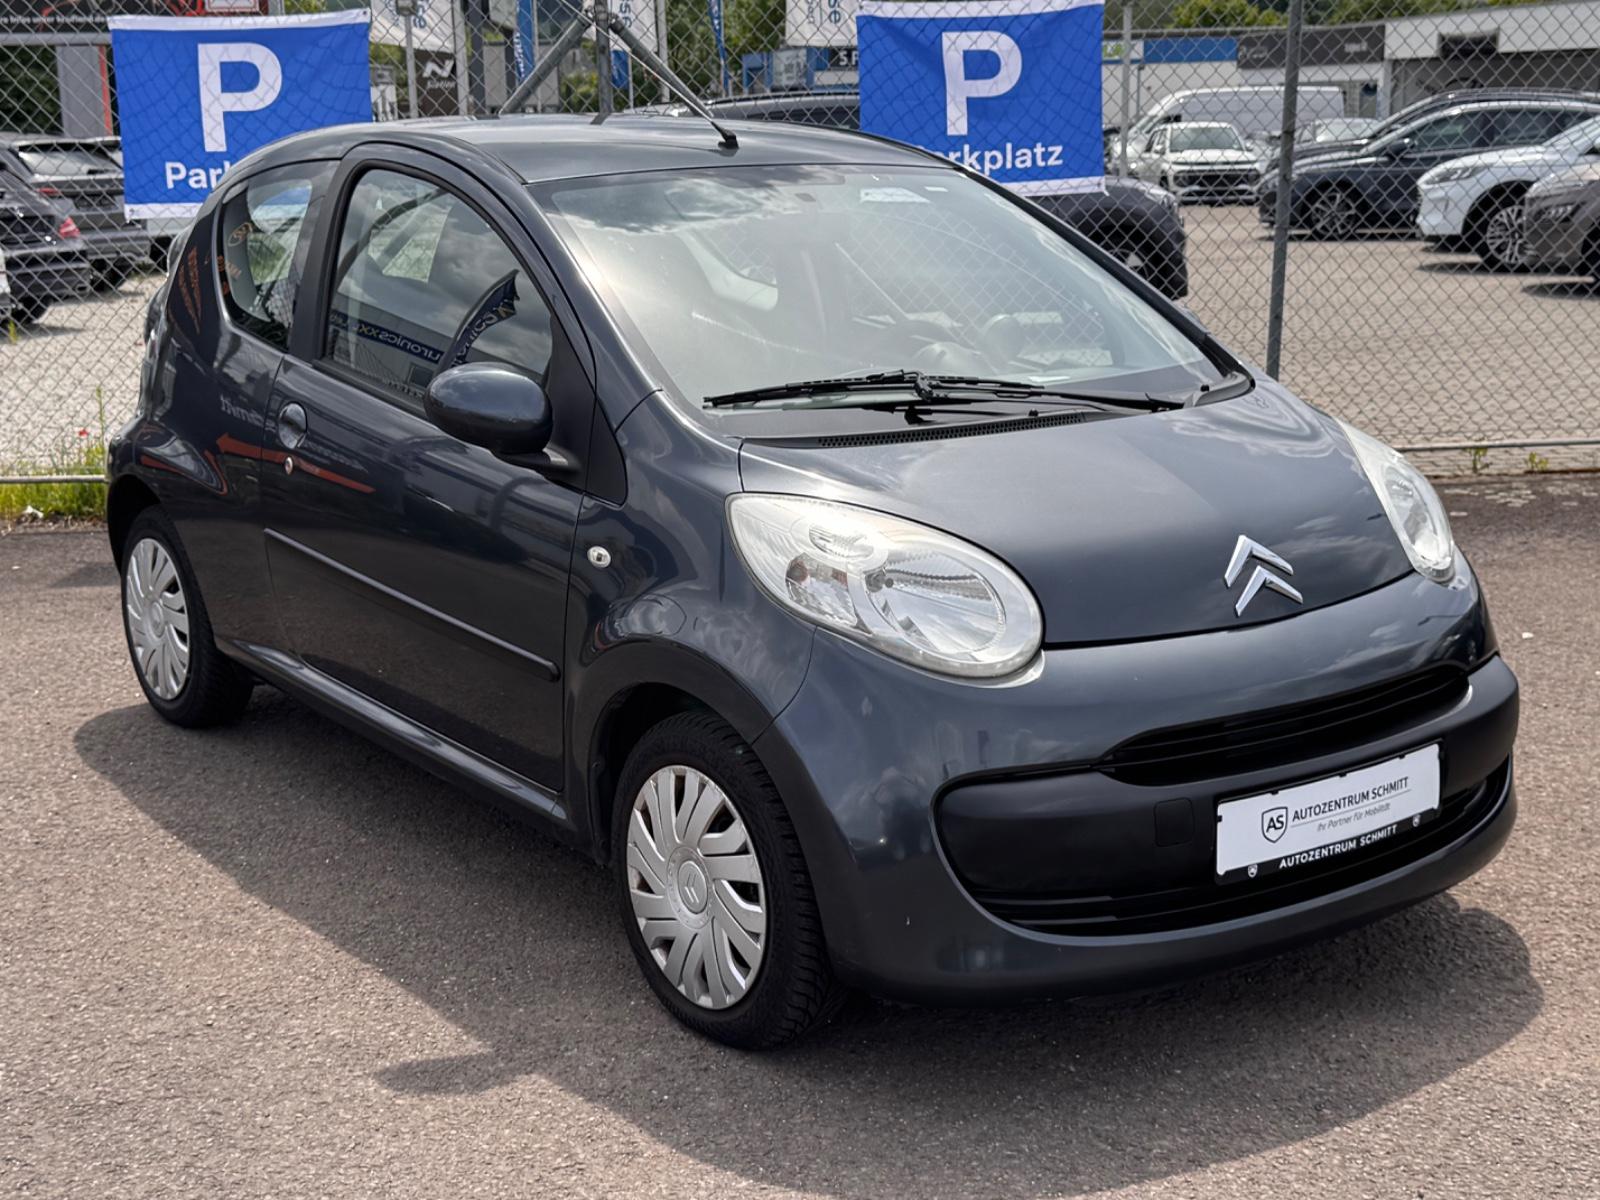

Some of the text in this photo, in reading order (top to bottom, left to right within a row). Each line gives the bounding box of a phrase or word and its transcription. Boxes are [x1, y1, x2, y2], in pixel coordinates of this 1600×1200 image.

[197, 42, 283, 153] P
[942, 30, 1023, 136] P
[932, 142, 1063, 177] rkplatz
[1292, 776, 1409, 822] AUTOZENTRUM SCHMITT
[1265, 814, 1285, 833] AS
[1279, 823, 1398, 869] AUTOZENTRUM SCHMITT
[1317, 822, 1327, 832] Ihr
[1327, 815, 1353, 829] Partner
